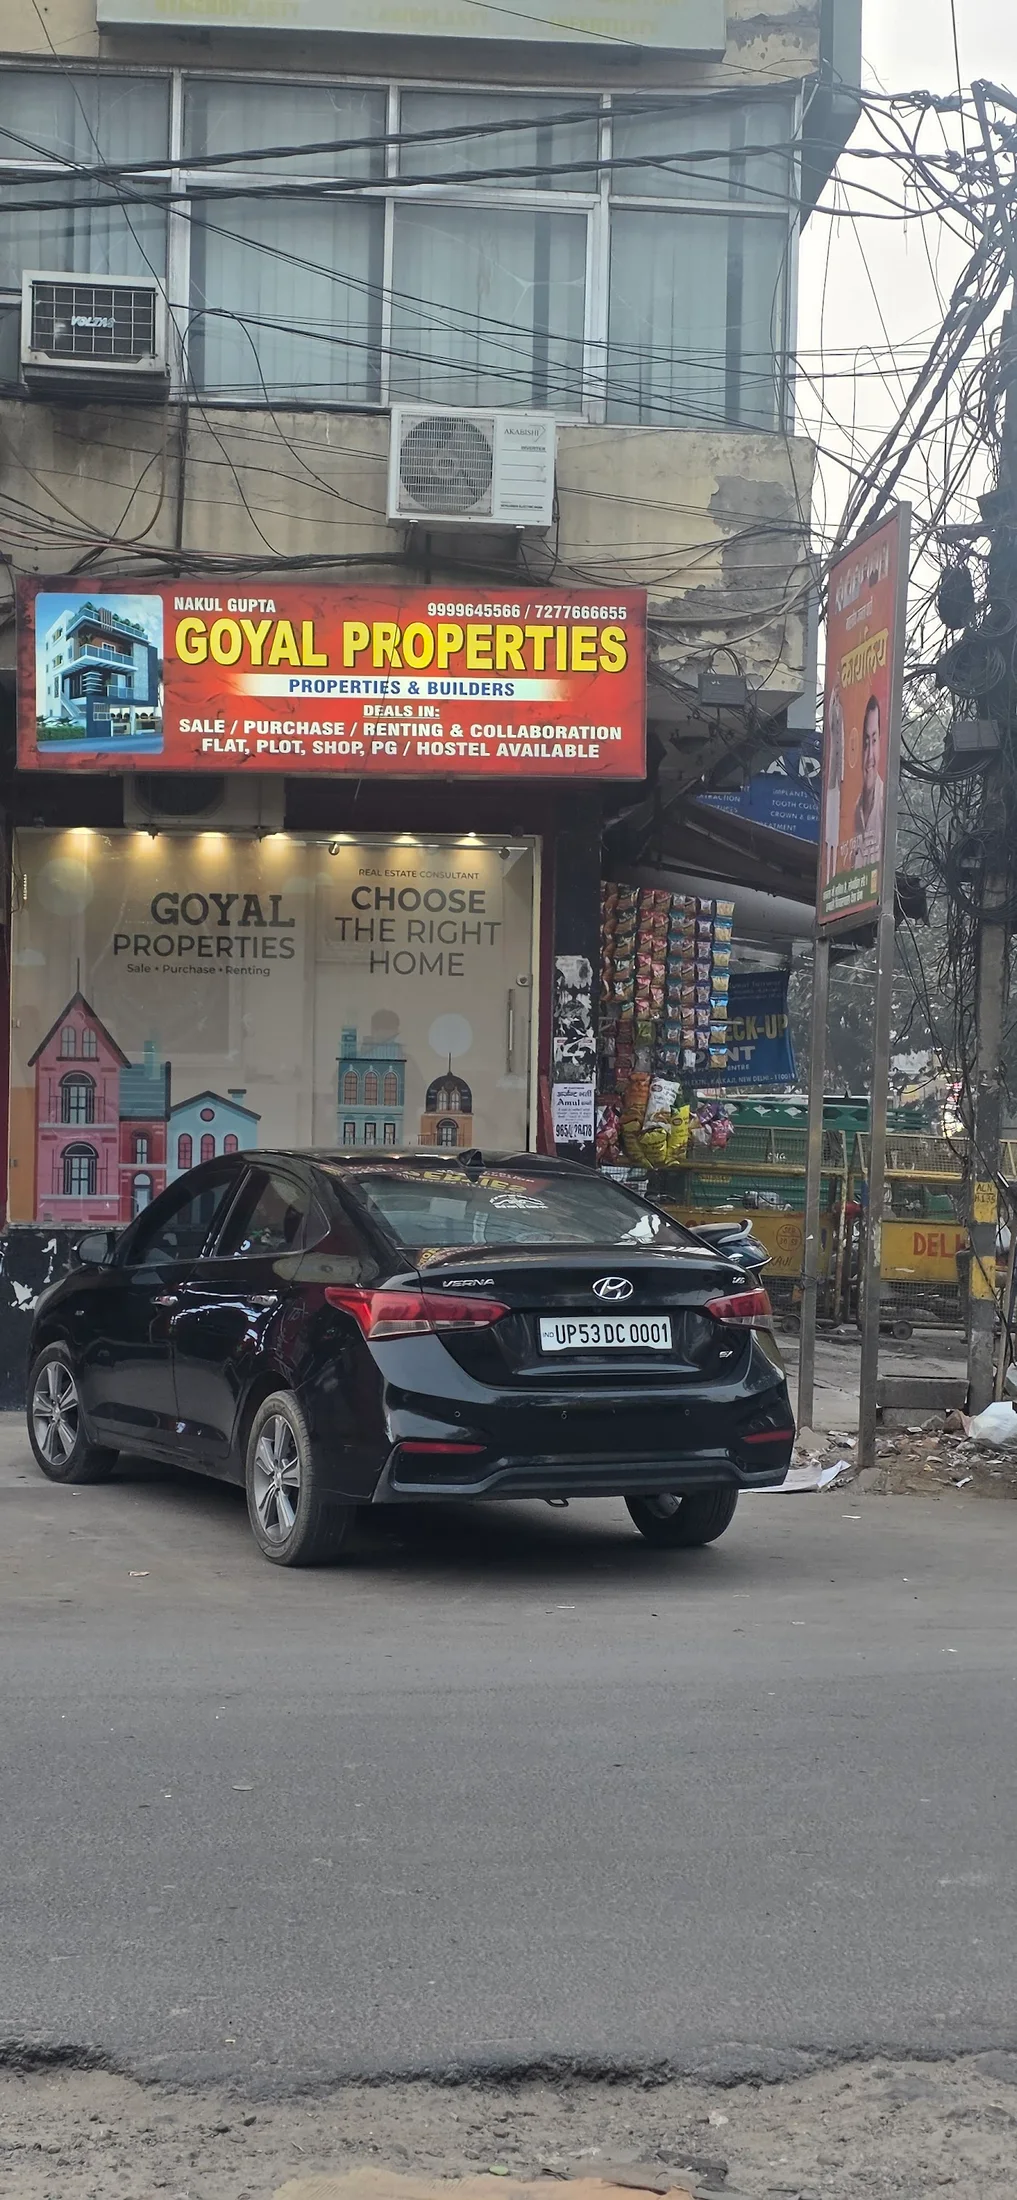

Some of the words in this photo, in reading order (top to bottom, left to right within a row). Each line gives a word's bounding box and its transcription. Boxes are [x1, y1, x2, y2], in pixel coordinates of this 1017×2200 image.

[174, 597, 222, 612] NAKUL
[227, 598, 276, 613] GUPTA
[427, 602, 520, 618] 9999645566
[524, 604, 531, 619] /
[535, 605, 627, 620] 7277666655
[175, 616, 329, 667] GOYAL
[342, 619, 628, 673] PROPERTIES
[840, 627, 889, 688] कार्यालय
[289, 679, 401, 695] PROPERTIES
[408, 681, 420, 695] &
[427, 681, 515, 697] BUILDERS
[363, 704, 413, 718] DEALS
[418, 705, 440, 718] IN:
[179, 719, 225, 733] SALE
[230, 720, 238, 735] /
[243, 720, 345, 736] PURCHASE
[350, 722, 358, 737] /
[363, 722, 443, 738] RENTING
[450, 724, 463, 738] &
[470, 724, 622, 740] COLLABORATION
[202, 738, 250, 755] FLAT,
[256, 739, 306, 756] PLOT,
[312, 740, 365, 757] SHOP,
[371, 741, 398, 756] PG
[403, 741, 411, 757] /
[417, 742, 490, 757] HOSTEL
[496, 743, 600, 758] AVAILABLE
[772, 799, 797, 808] TOOTH
[770, 810, 797, 819] CROWN
[358, 868, 383, 877] REAL
[384, 869, 417, 878] ESTATE
[419, 871, 480, 880] CONSULTANT
[351, 886, 486, 914] CHOOSE
[151, 892, 296, 928] GOYAL
[334, 916, 396, 943] THE
[407, 919, 502, 946] RIGHT
[113, 933, 296, 960] PROPERTIES
[126, 963, 151, 974] Sale
[162, 964, 216, 975] Purchase
[225, 965, 271, 977] Renting
[369, 950, 465, 977] HOME
[738, 1075, 752, 1083] NEW
[556, 1098, 580, 1106] Amul
[442, 1278, 495, 1288] VERNA
